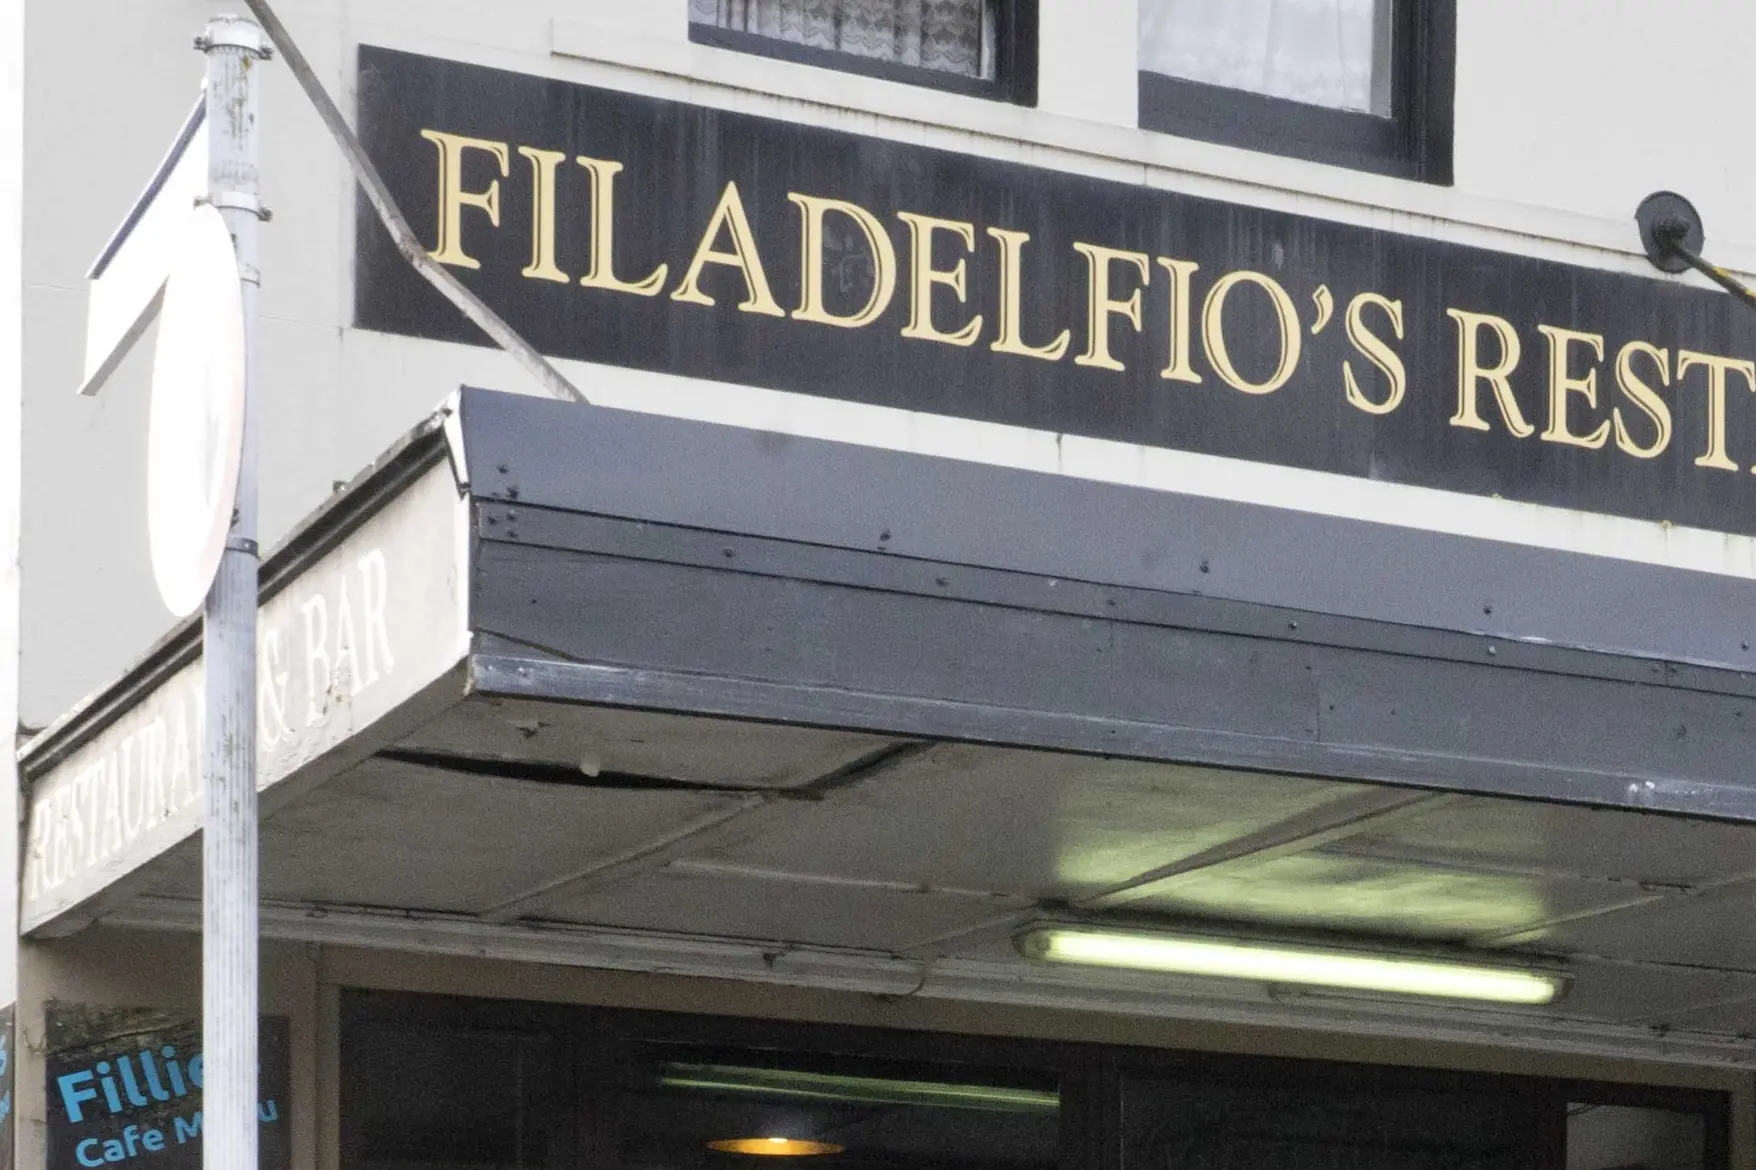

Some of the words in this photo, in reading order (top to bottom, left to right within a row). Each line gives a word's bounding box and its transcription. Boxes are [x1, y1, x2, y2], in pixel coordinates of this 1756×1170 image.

[421, 129, 1405, 415] FILADELFIO'S
[29, 690, 204, 900] RESTAURA
[302, 547, 396, 730] BAR
[57, 1045, 204, 1124] Filli
[75, 1124, 166, 1168] Cafe
[173, 1099, 278, 1145] Mu
